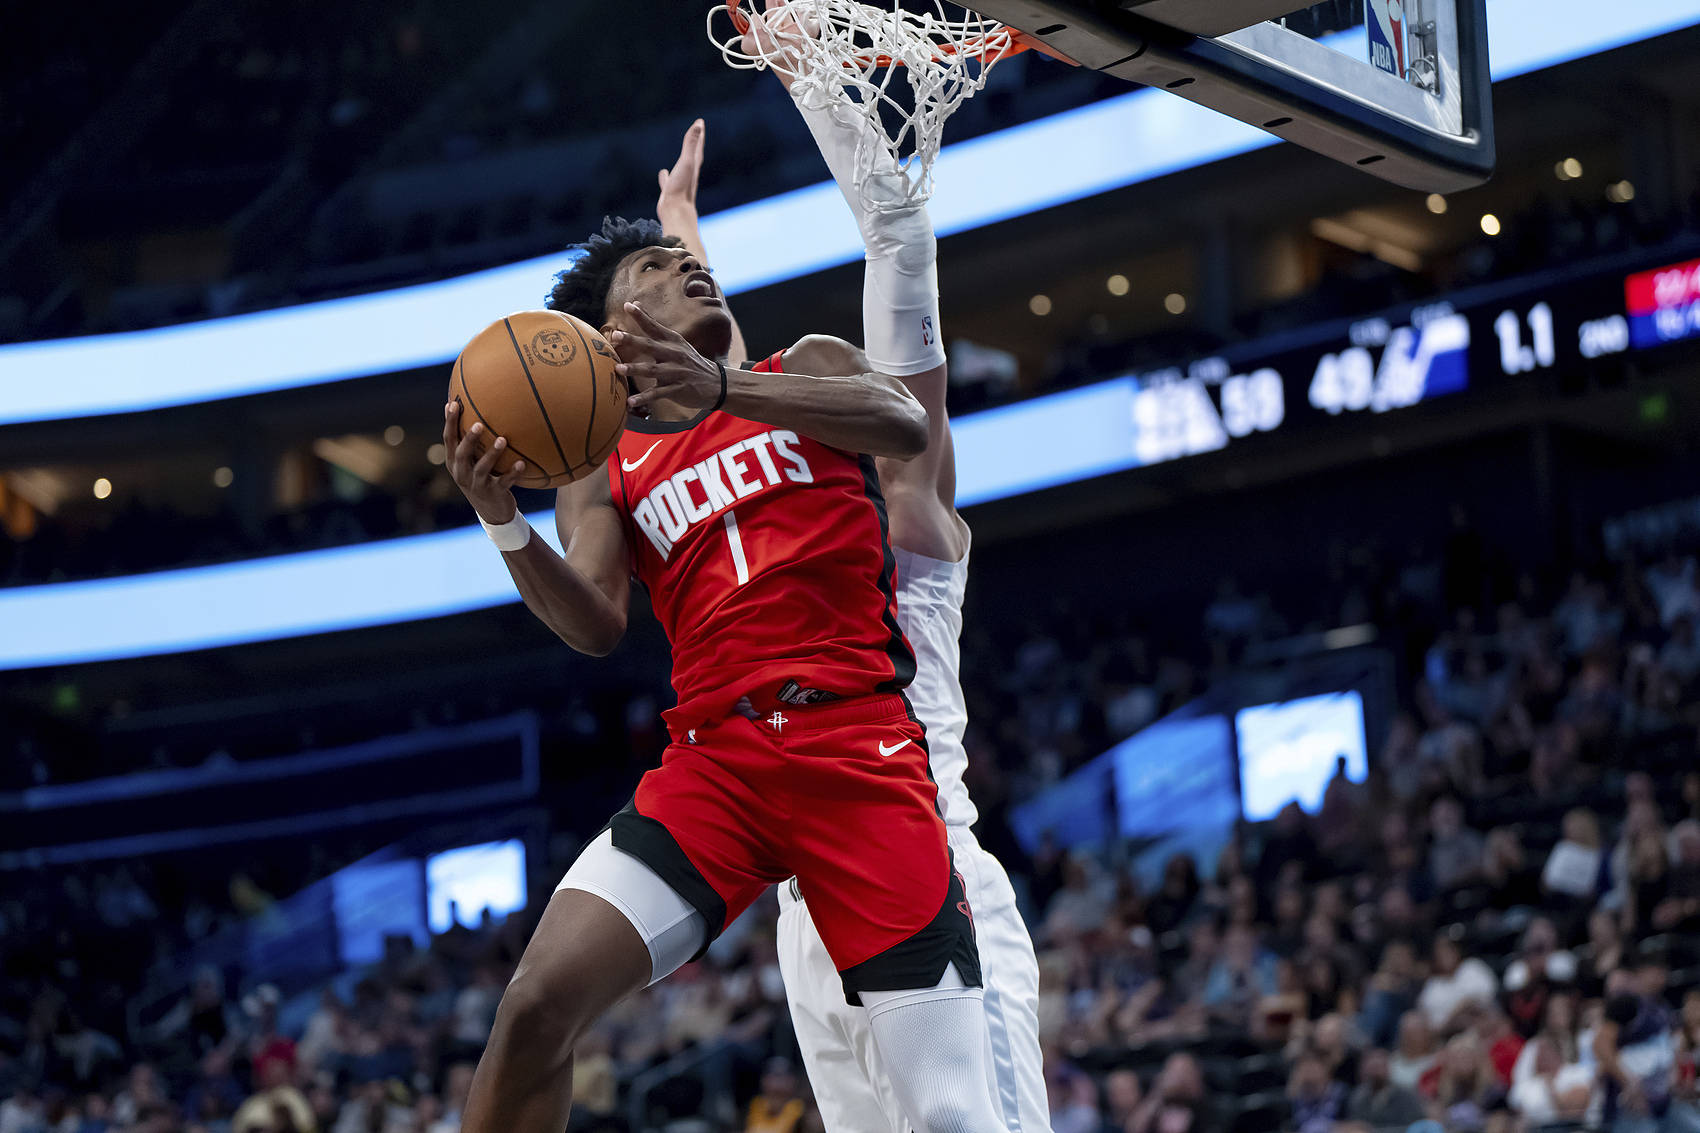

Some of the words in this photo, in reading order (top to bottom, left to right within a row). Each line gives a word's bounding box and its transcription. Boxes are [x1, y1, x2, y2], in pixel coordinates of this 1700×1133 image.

[1372, 41, 1393, 71] NBA
[1494, 302, 1555, 375] 1.1
[632, 430, 814, 562] ROCKETS
[723, 510, 749, 586] 1
